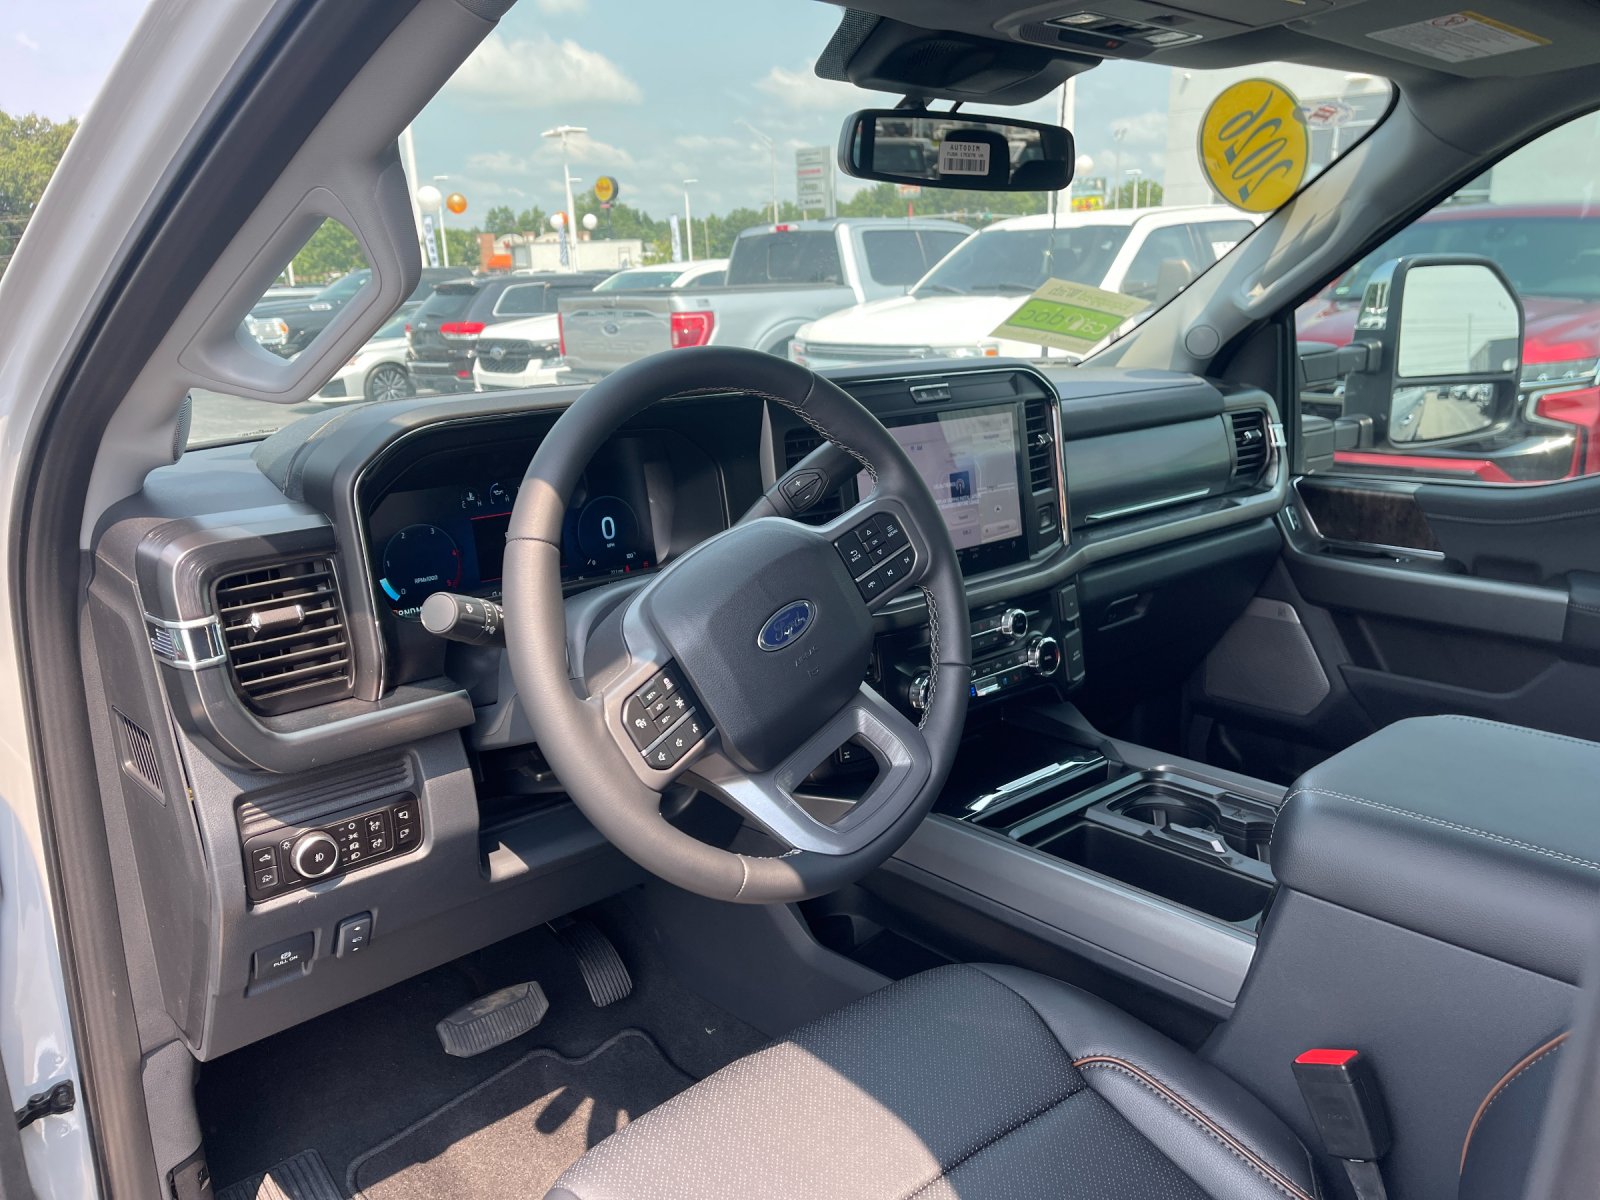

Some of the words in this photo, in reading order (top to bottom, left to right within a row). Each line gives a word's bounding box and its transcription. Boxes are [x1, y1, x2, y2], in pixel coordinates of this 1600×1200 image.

[950, 144, 981, 152] AUTODIM
[601, 516, 616, 540] 0
[401, 532, 406, 540] 2
[851, 553, 861, 563] BACK
[774, 610, 806, 642] Ford
[273, 959, 288, 967] PULL
